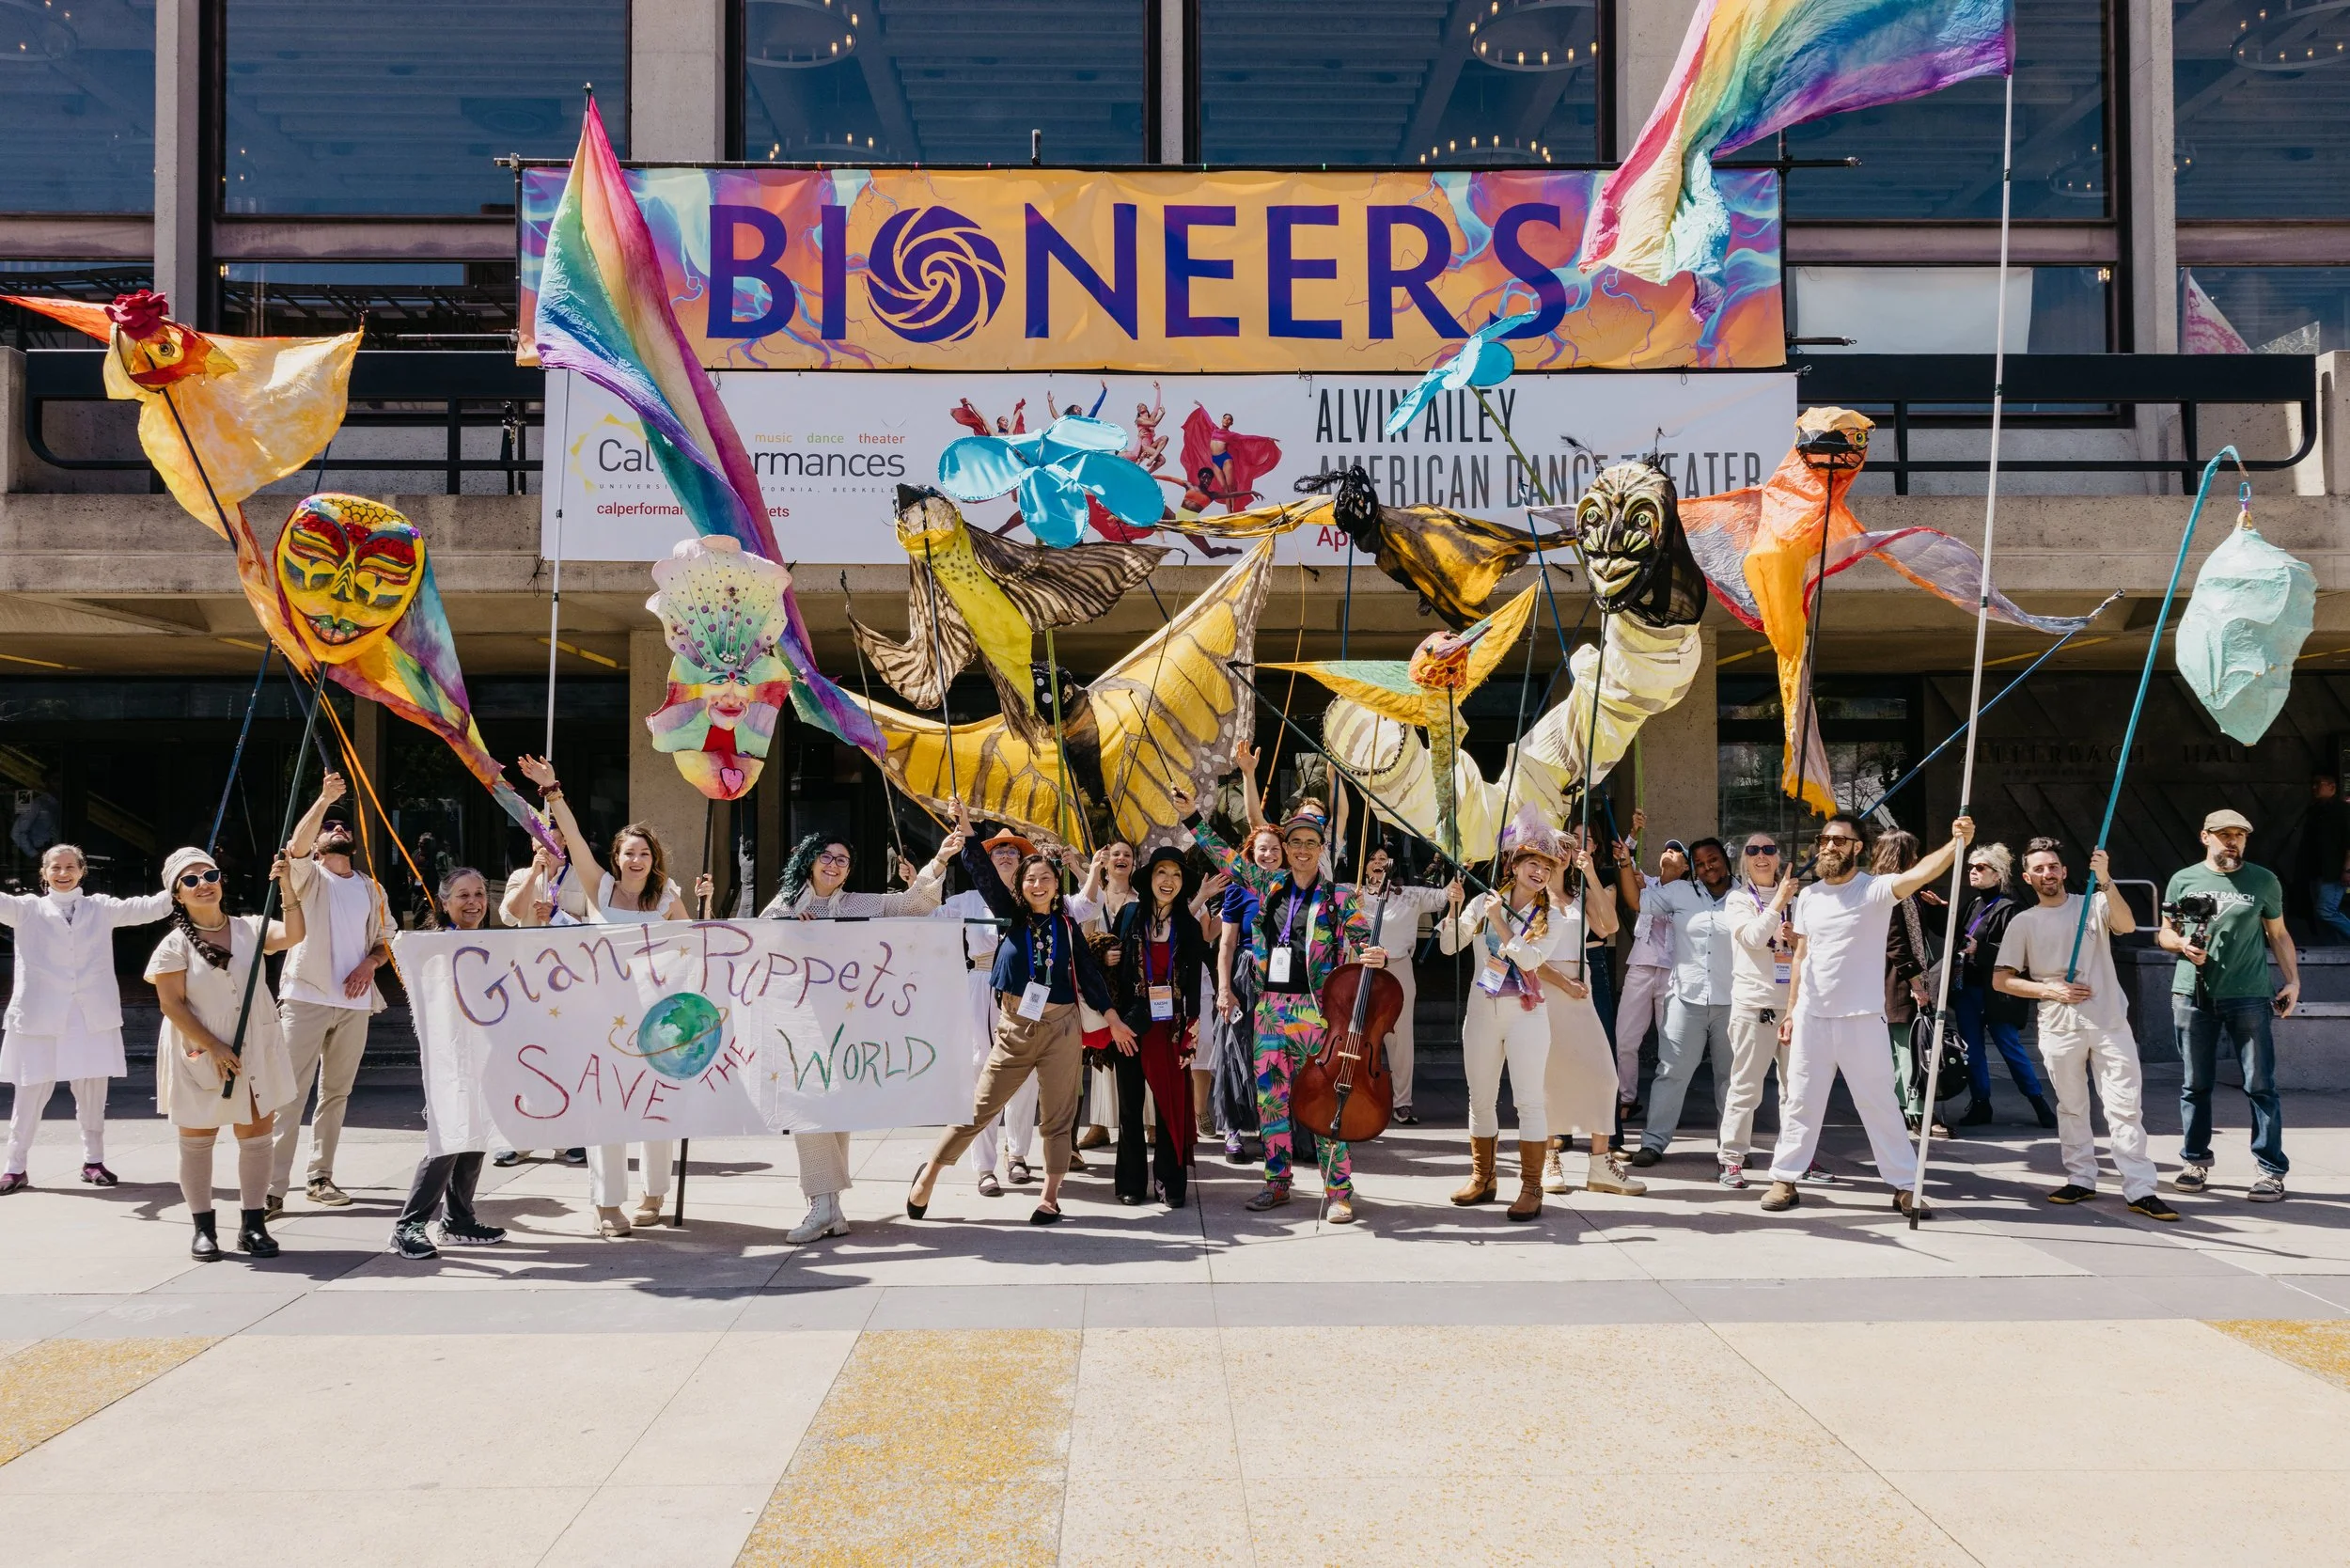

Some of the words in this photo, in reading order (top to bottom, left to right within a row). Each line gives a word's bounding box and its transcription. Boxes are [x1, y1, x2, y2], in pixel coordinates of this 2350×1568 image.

[707, 201, 1567, 343] BIONEERS
[755, 432, 793, 444] music
[807, 431, 844, 444] dance
[859, 431, 905, 445] theater
[1424, 388, 1516, 444] AILEY
[598, 438, 654, 473] Cal
[1506, 453, 1609, 509] DANC
[1621, 451, 1762, 499] EATER
[2220, 891, 2255, 902] RANCH
[452, 923, 668, 1027] Giant
[690, 922, 917, 1018] Puppets
[515, 1043, 681, 1122] SAVE
[698, 1035, 755, 1093] THE
[775, 1023, 937, 1092] WORLD
